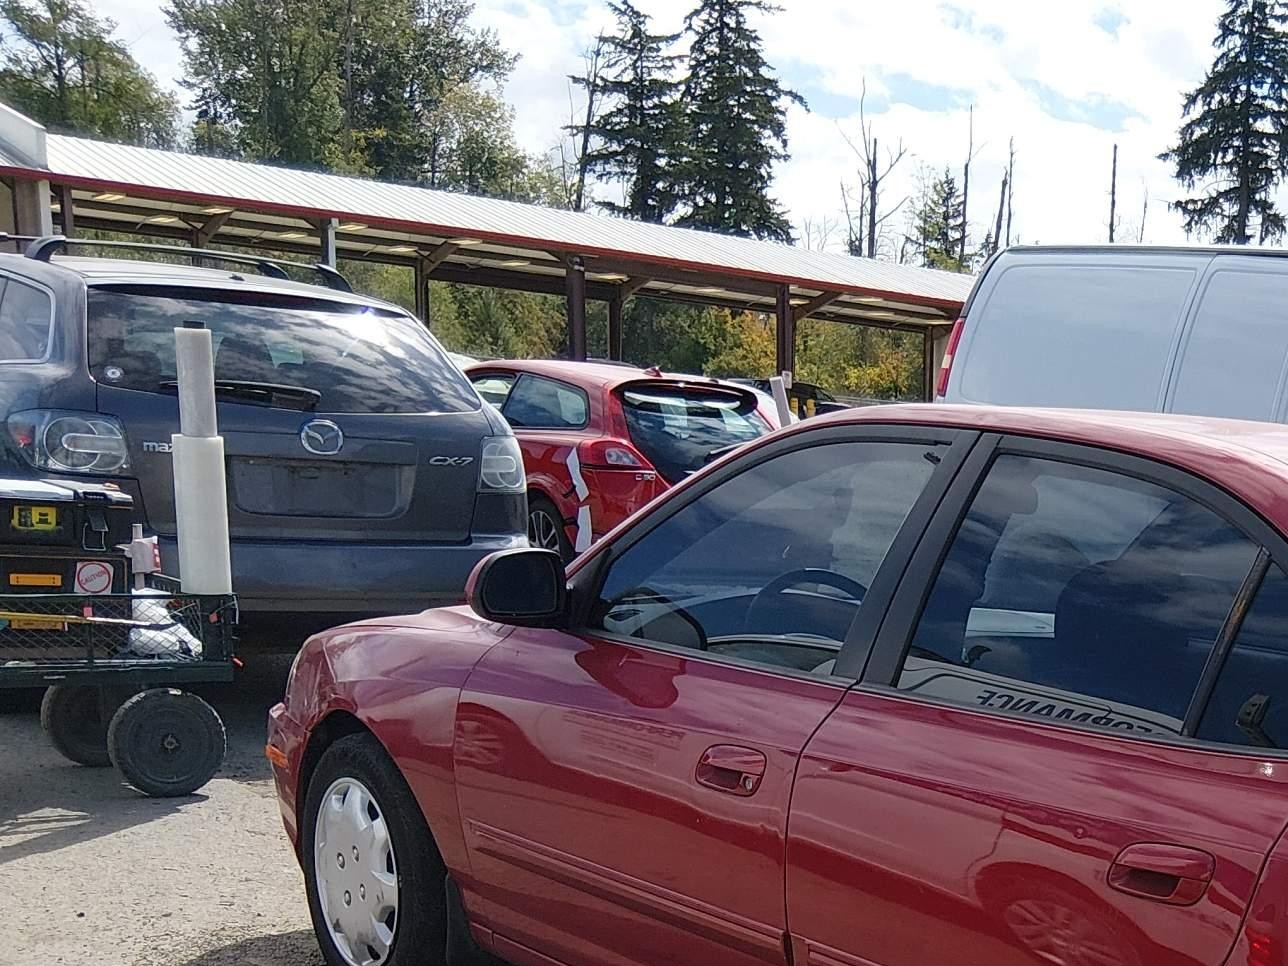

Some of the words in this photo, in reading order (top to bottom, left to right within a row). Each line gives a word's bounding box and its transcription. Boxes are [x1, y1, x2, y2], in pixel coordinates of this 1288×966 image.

[143, 441, 173, 453] maz
[429, 455, 474, 467] CX-7
[79, 569, 108, 586] CAUTION
